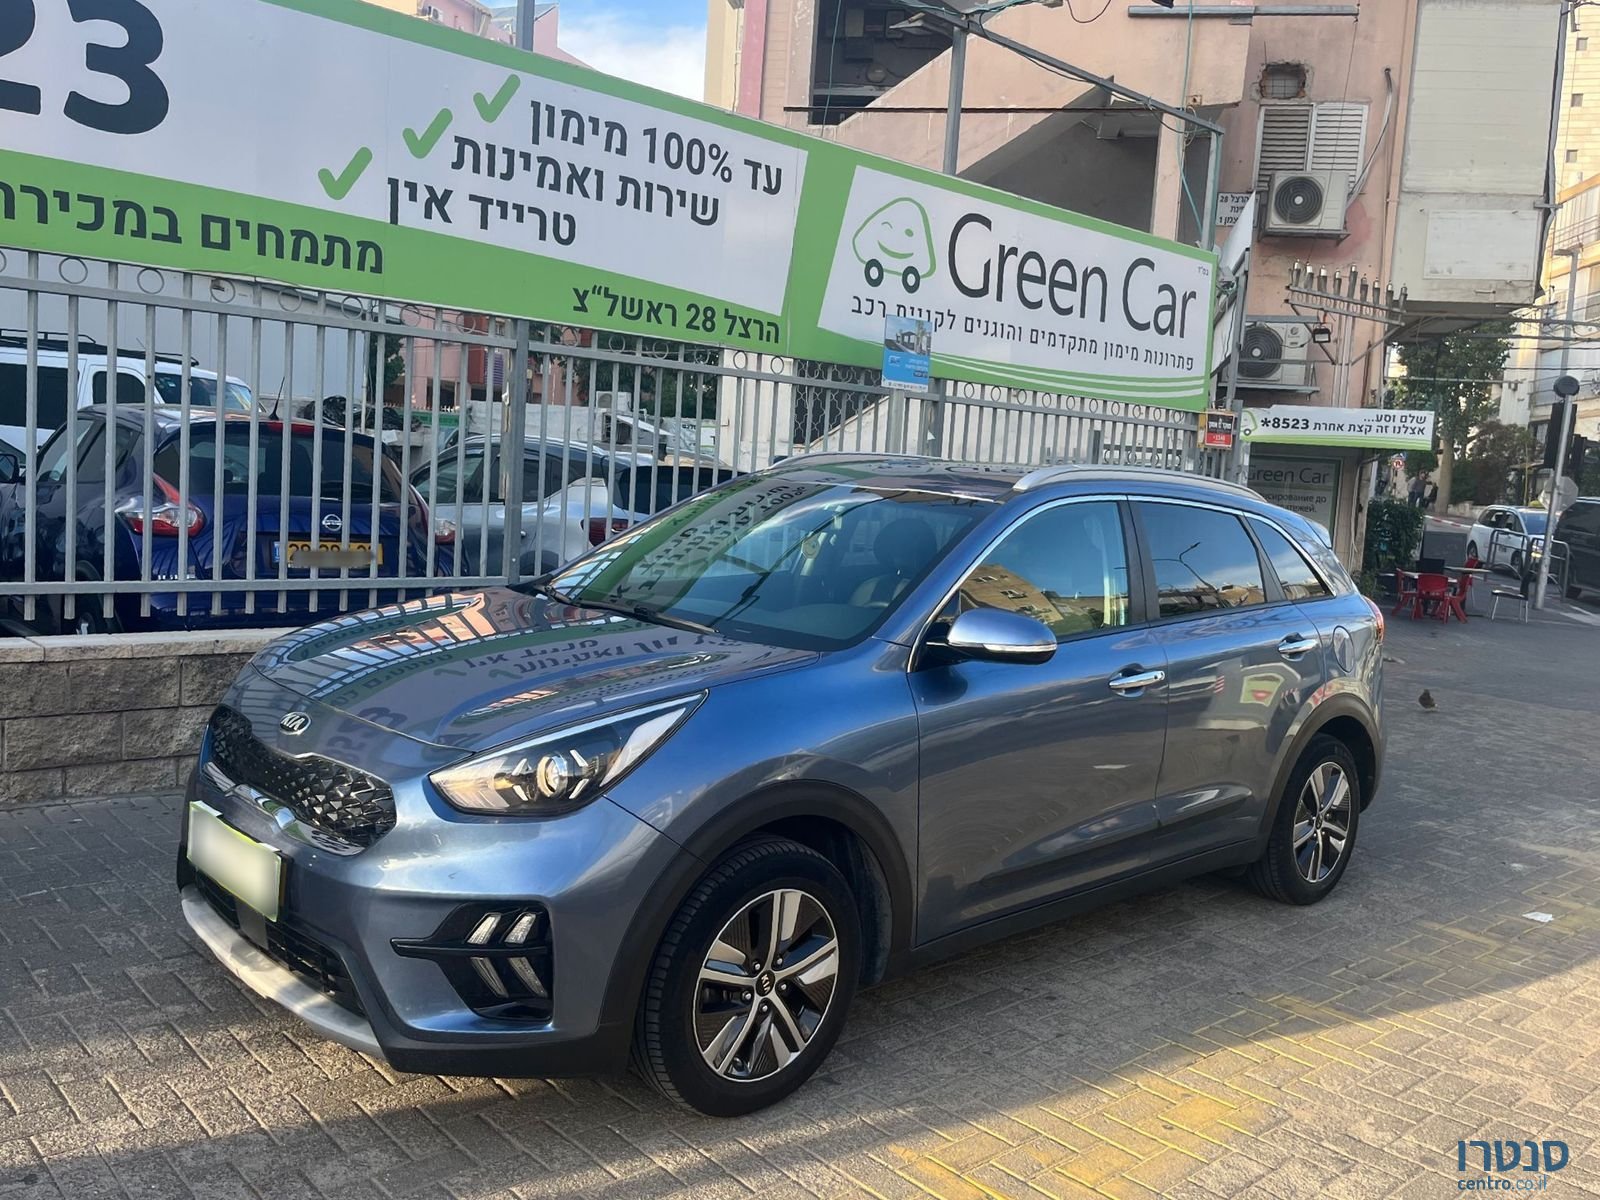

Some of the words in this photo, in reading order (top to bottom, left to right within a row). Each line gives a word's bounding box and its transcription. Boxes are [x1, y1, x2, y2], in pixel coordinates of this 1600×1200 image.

[531, 101, 628, 156] מימון
[451, 136, 604, 201] ואמינות
[643, 128, 733, 184] 100%
[744, 159, 781, 195] עד
[388, 177, 454, 226] אין
[616, 175, 719, 225] שירות
[1219, 195, 1229, 203] 28
[469, 194, 576, 245] טרייד
[201, 214, 383, 274] מתמחים
[948, 213, 1107, 323] Green
[1123, 258, 1197, 338] Car
[686, 304, 715, 332] 28
[852, 296, 888, 319] רכב
[724, 308, 779, 343] הרצל
[965, 317, 1022, 341] והוגנים
[1030, 329, 1098, 355] מתקדמים
[1104, 342, 1139, 361] מימון
[1144, 349, 1194, 371] פתרונות
[1313, 422, 1345, 432] אחרת
[1348, 423, 1373, 436] קצת
[1376, 424, 1390, 434] זה
[1393, 425, 1426, 436] אצלנו
[1400, 414, 1427, 425] שלם
[1300, 467, 1329, 484] Car
[280, 714, 306, 731] KIA
